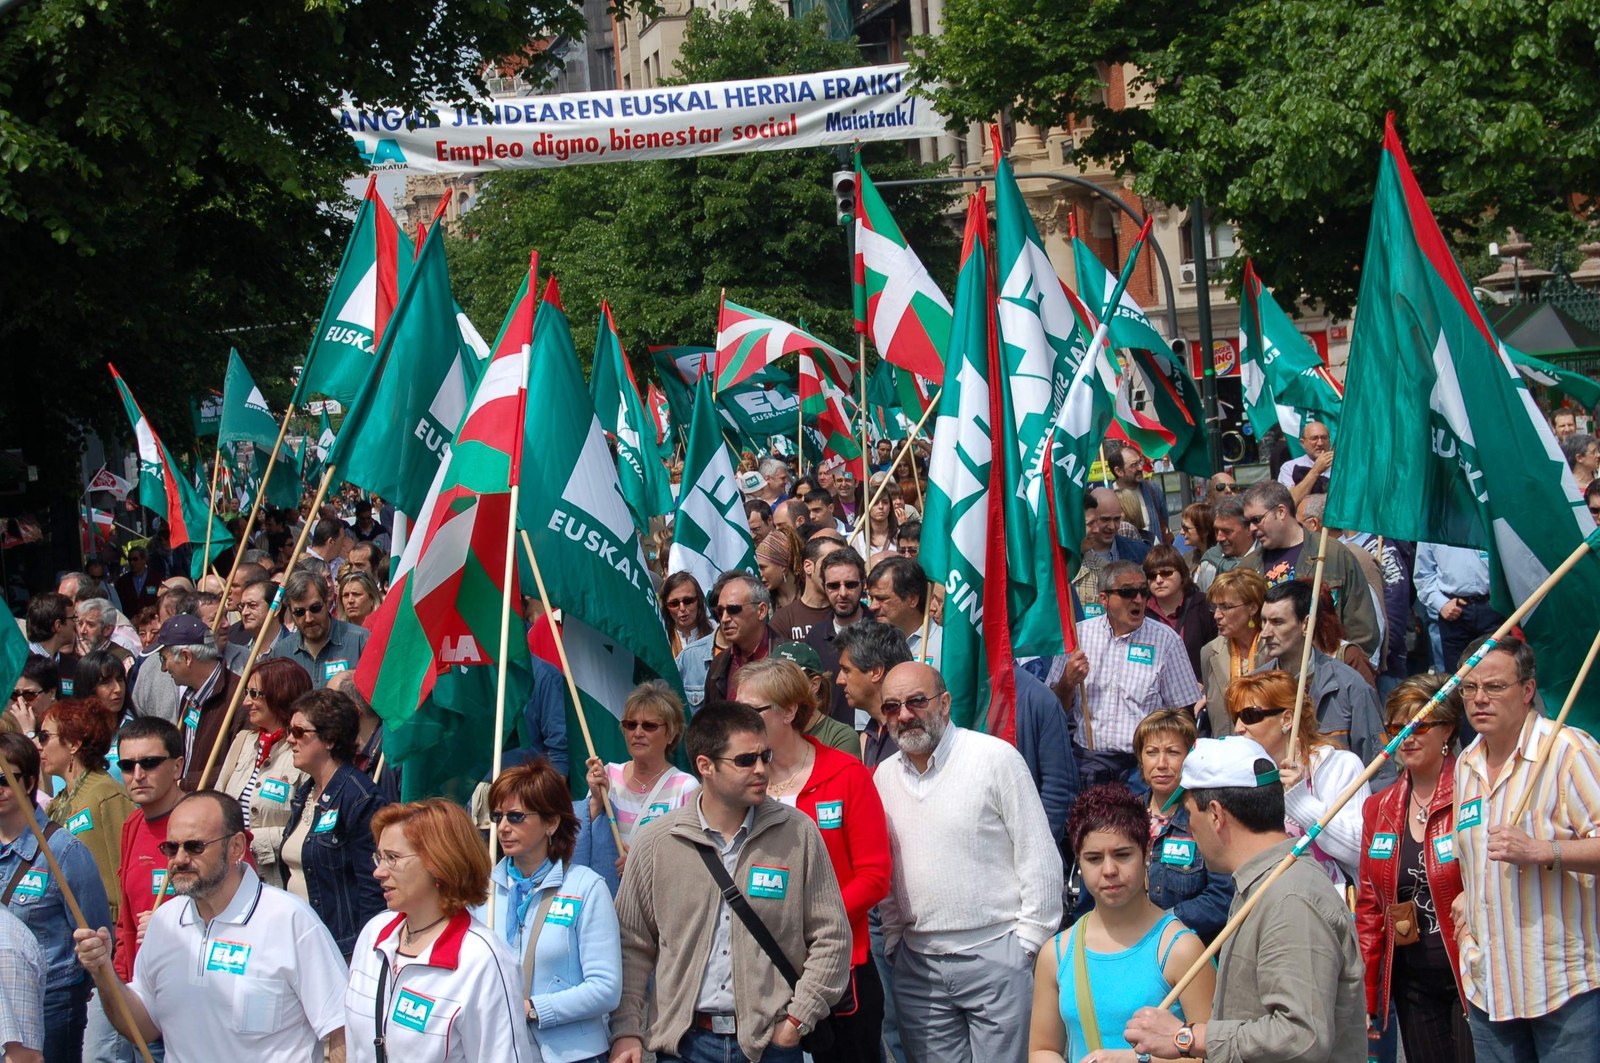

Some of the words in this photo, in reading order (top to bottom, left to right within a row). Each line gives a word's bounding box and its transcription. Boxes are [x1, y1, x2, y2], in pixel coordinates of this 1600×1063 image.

[339, 109, 441, 132] ANGILE
[452, 97, 614, 127] JENDEAREN
[620, 90, 718, 117] EUSKAL
[724, 80, 817, 108] HERRIA
[823, 72, 901, 100] ERAIKI
[825, 105, 907, 132] Maiatzak
[436, 136, 523, 166] Empleo
[533, 133, 606, 161] digno,
[610, 126, 722, 151] bienestar
[732, 113, 797, 141] social
[1215, 345, 1231, 355] RGER
[1215, 351, 1232, 365] ING
[734, 390, 799, 415] EL
[548, 508, 641, 590] EUSKAL
[441, 635, 481, 662] LA
[1164, 843, 1191, 857] ELA
[752, 873, 783, 889] ELA
[211, 947, 246, 965] ELA
[397, 996, 429, 1021] ELA
